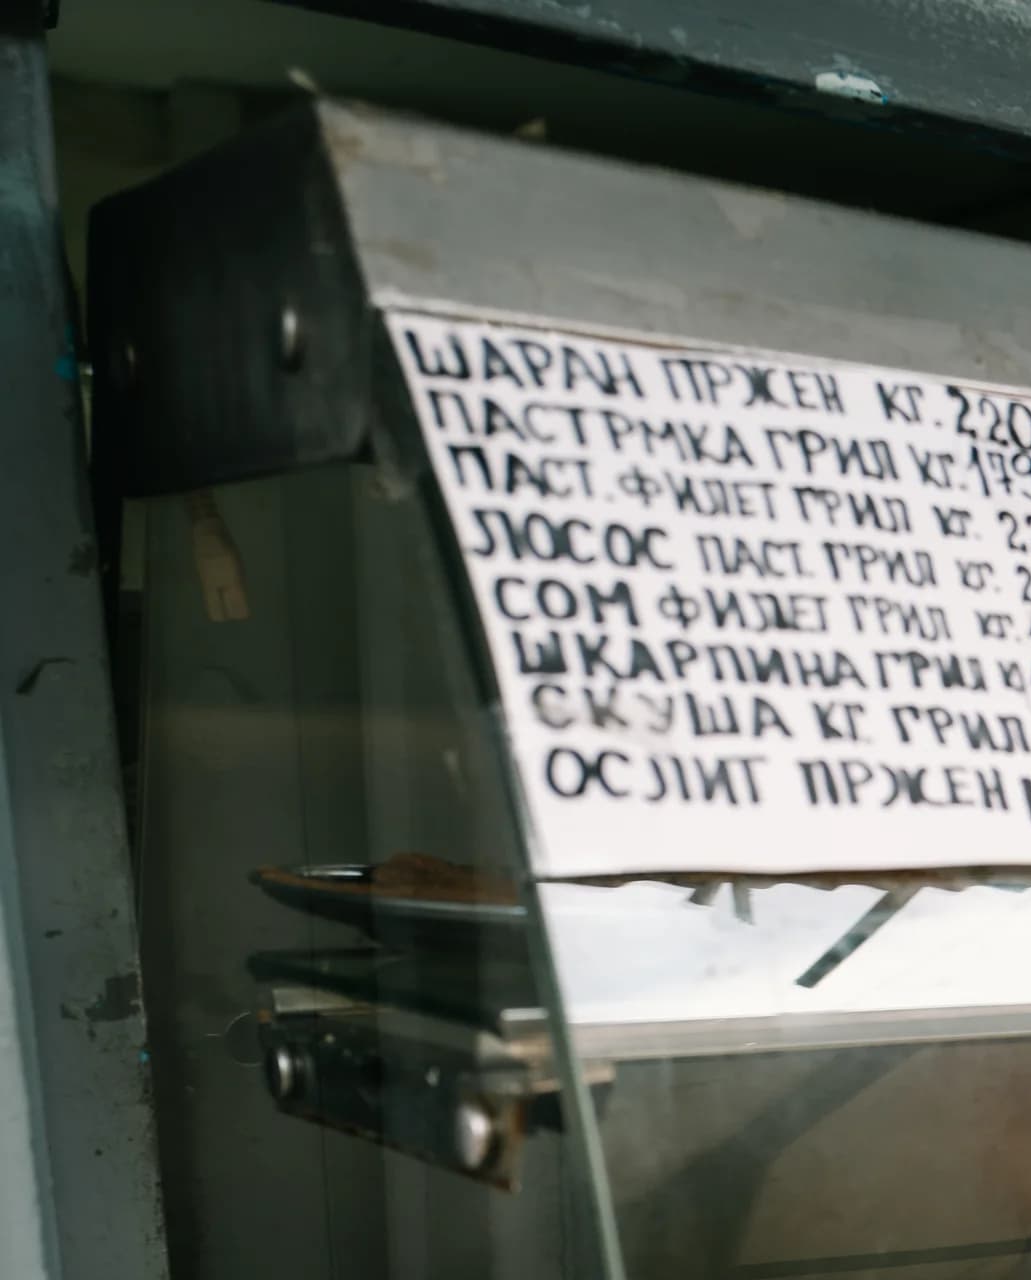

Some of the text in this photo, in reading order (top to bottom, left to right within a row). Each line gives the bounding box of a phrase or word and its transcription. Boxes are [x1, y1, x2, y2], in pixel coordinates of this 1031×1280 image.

[404, 329, 645, 397] ШАРАН
[660, 358, 844, 413] ПРЖЕН
[764, 427, 899, 480] ГРИЛ
[617, 465, 777, 522] ФИЛЕТ
[793, 486, 911, 534] ГРИЛ
[472, 508, 673, 570] ЛОСОС
[822, 542, 936, 587] ГРИЛ
[494, 577, 641, 627] СОМ
[657, 583, 827, 632] ФИЛЕТ
[845, 594, 951, 641] ГРИЛ
[510, 630, 868, 690] ШКАРПИНА
[532, 682, 793, 738] СКУША
[546, 749, 768, 806] ОСЛИТ
[797, 758, 1009, 811] ПРЖЕН
